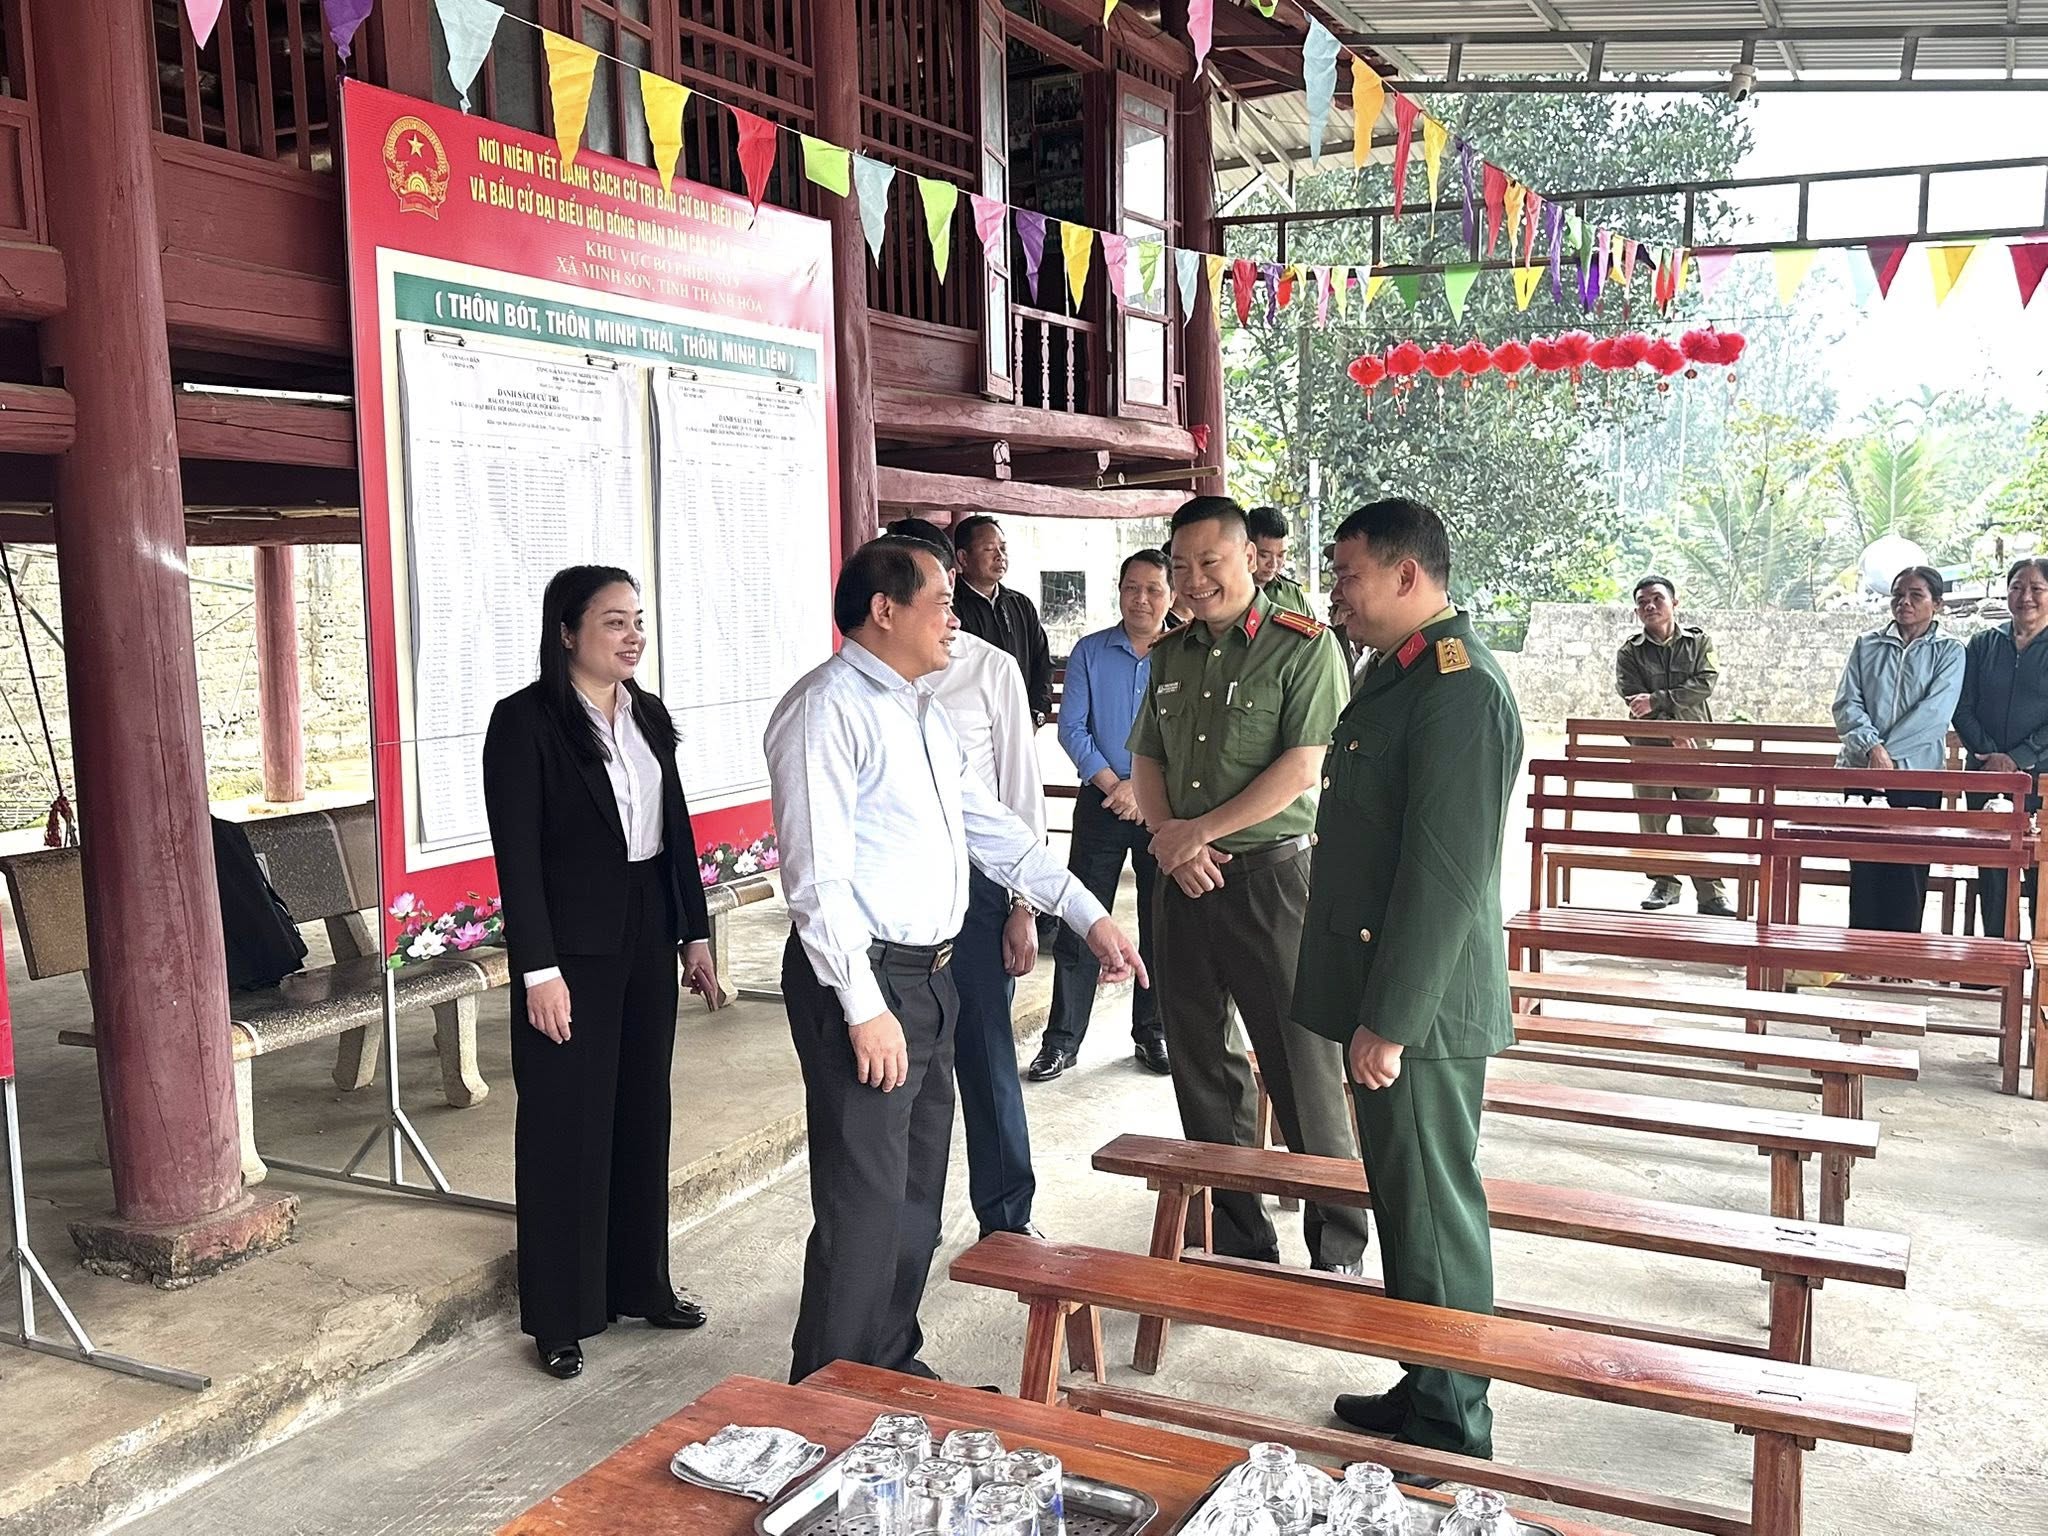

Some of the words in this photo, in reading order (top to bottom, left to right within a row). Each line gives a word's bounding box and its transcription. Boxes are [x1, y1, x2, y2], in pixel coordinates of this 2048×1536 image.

[470, 172, 488, 204] VÀ
[517, 182, 534, 215] CỬ
[536, 194, 555, 224] ĐẠI
[558, 194, 584, 227] BIỂU
[586, 204, 604, 236] HỘI
[607, 208, 635, 240] ĐỒNG
[637, 218, 665, 248] NHÂN
[668, 224, 687, 254] DÂN
[478, 136, 500, 165] NƠI
[504, 142, 534, 174] NIÊM
[536, 148, 556, 181] YẾT
[592, 166, 620, 198] SÁCH
[623, 172, 637, 203] CỬ
[639, 182, 655, 208] TRI
[679, 188, 692, 218] CỬ
[693, 198, 709, 226] ĐẠI
[711, 200, 732, 229] BIỂU
[556, 256, 580, 277] XÃ
[582, 262, 621, 284] MINH
[623, 270, 656, 294] SƠN,
[692, 285, 736, 308] THANH
[585, 240, 617, 262] KHU
[620, 250, 649, 272] VỰC
[448, 292, 499, 324] THÔN
[504, 301, 542, 335] BÓT,
[546, 308, 590, 340] THÔN
[594, 318, 637, 348] MINH
[640, 326, 678, 357] THÁI,
[681, 333, 718, 361] THÔN
[722, 341, 756, 367] MINH
[759, 346, 787, 372] LIÊN
